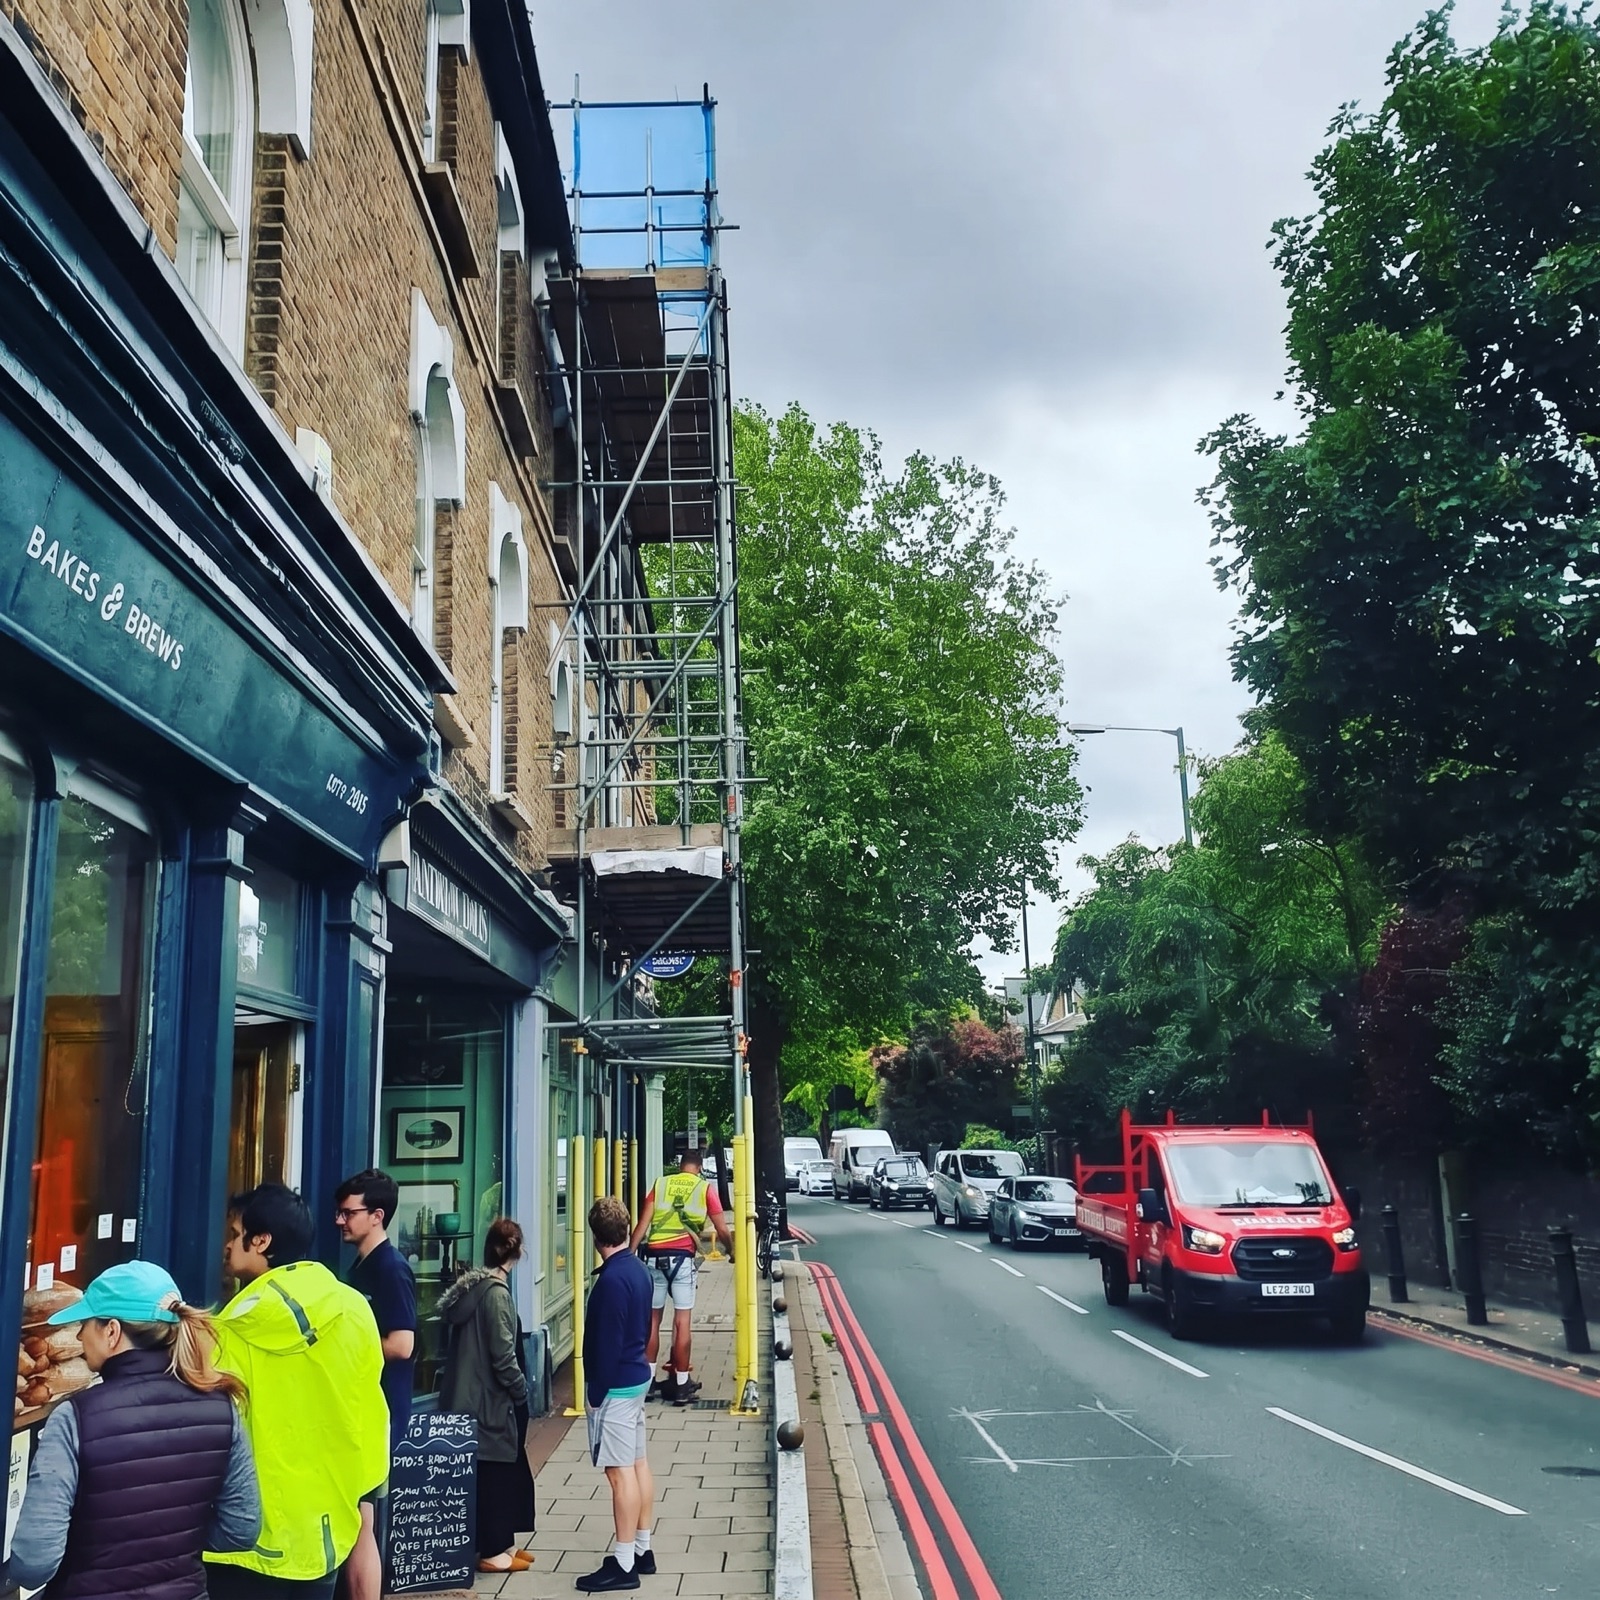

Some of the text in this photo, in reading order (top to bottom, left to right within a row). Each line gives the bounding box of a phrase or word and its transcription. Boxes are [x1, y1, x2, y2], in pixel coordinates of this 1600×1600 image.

[26, 524, 185, 670] BAKES & BREWS
[346, 786, 369, 815] 2015
[446, 1486, 468, 1496] ALL
